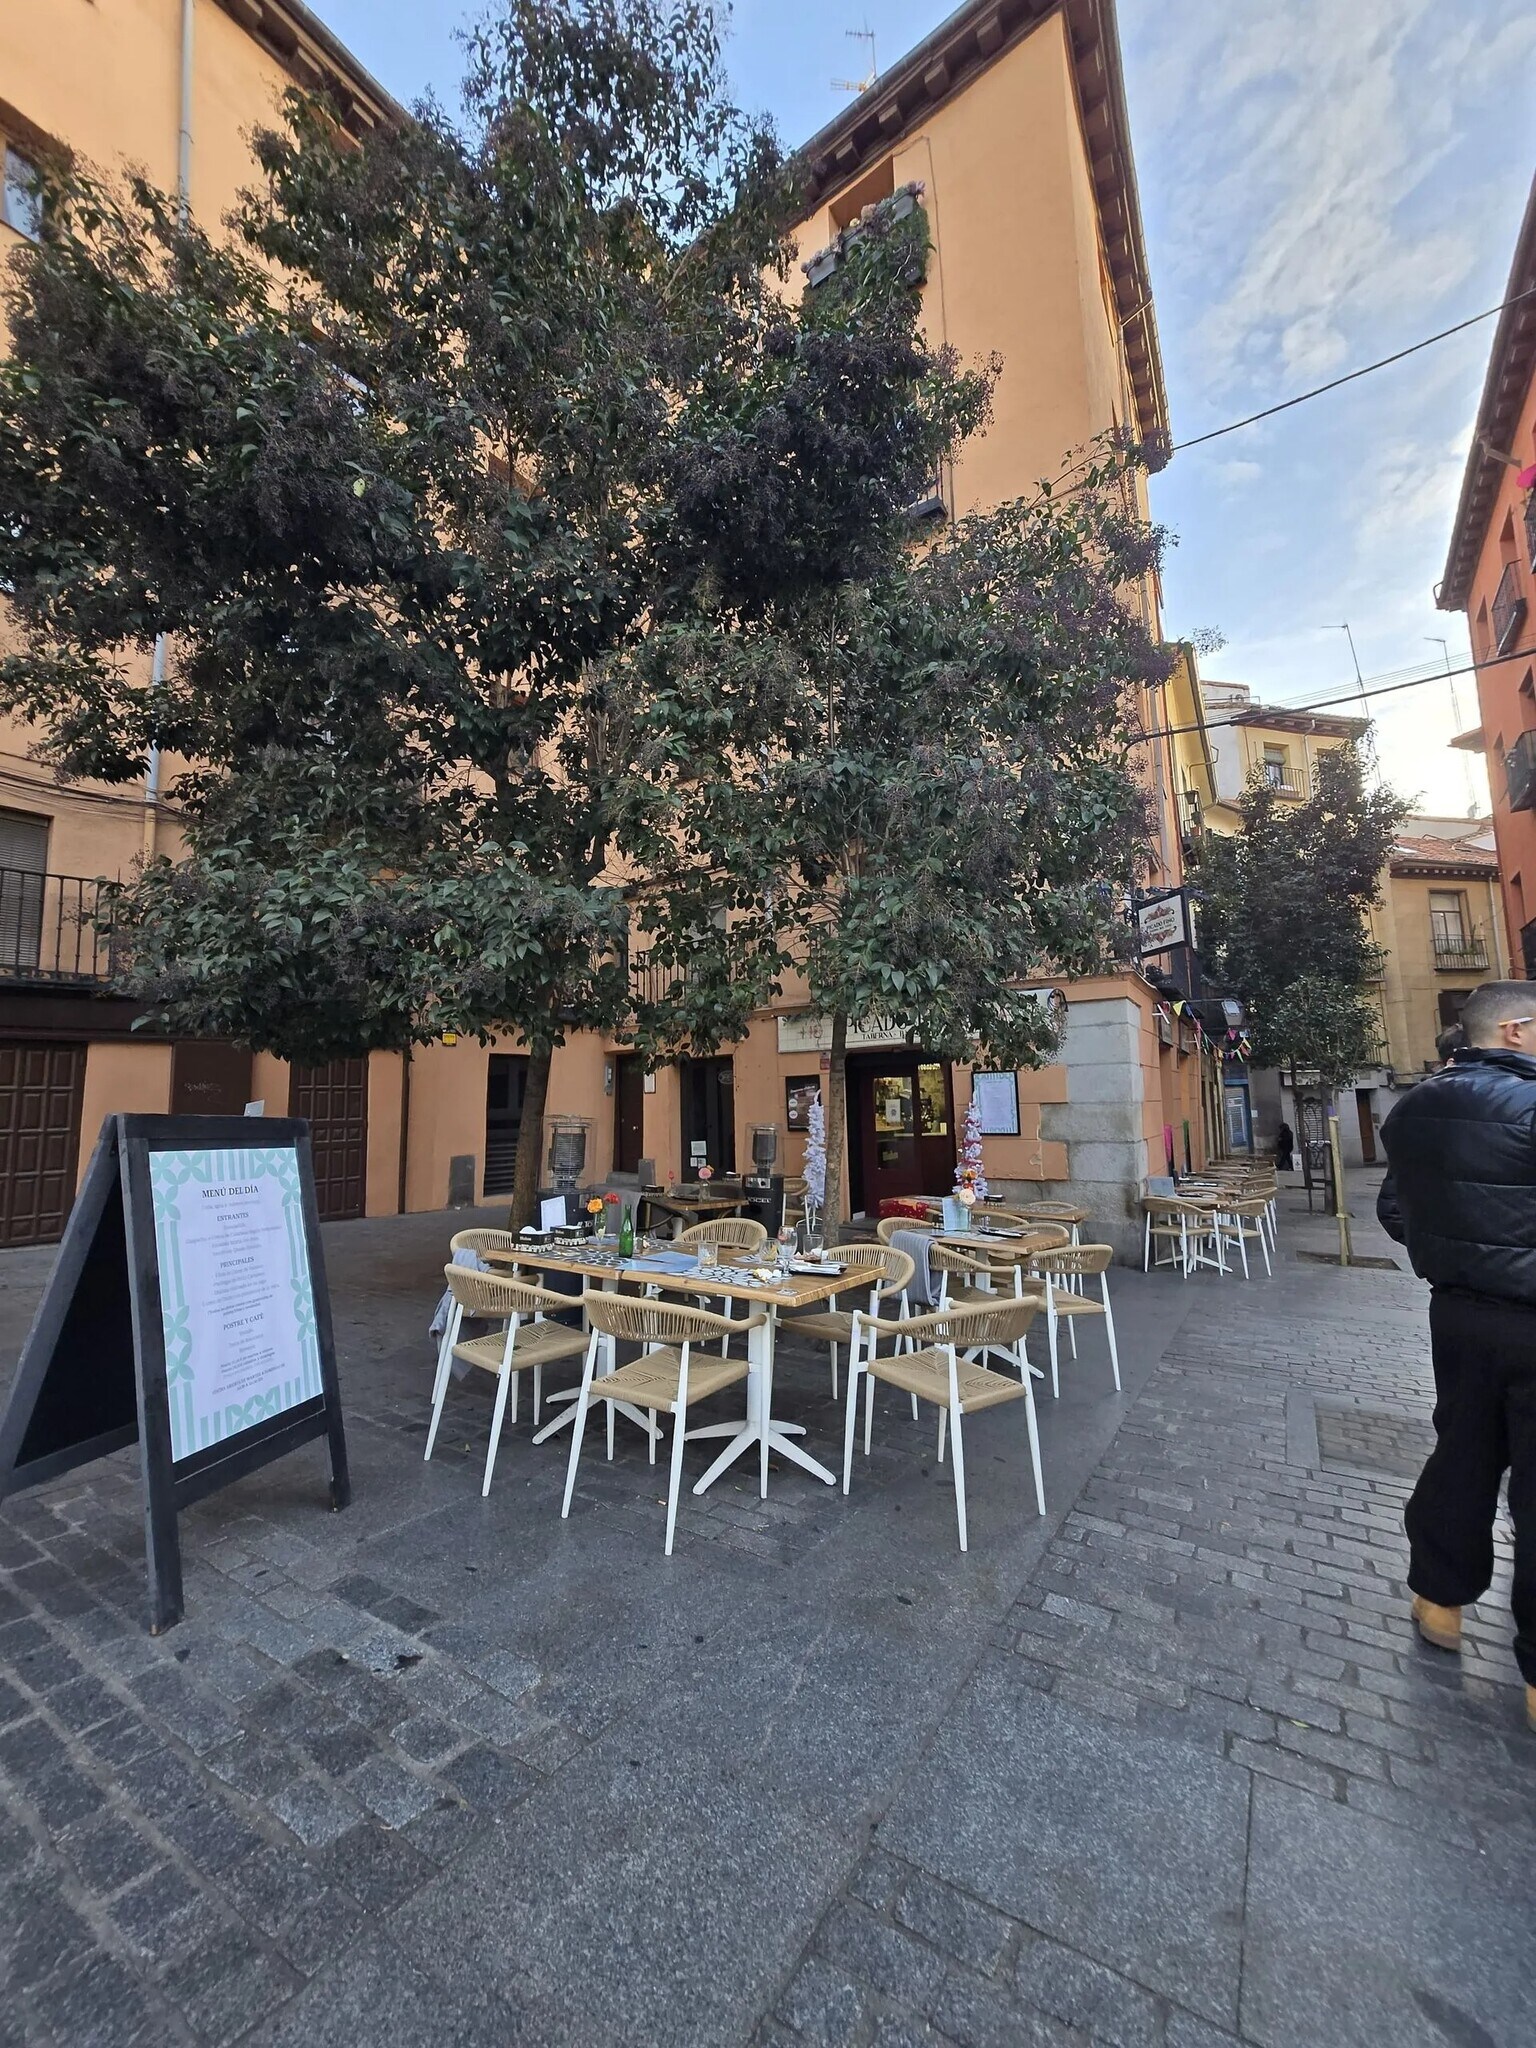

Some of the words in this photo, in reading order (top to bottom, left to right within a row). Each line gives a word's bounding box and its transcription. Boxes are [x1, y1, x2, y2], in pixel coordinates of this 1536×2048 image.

[862, 1031, 893, 1040] TABERNA
[202, 1187, 227, 1198] MENÚ
[229, 1186, 244, 1196] DEL
[245, 1184, 259, 1194] DÍA
[216, 1211, 249, 1222] ENTRANTES
[220, 1256, 255, 1269] PRINCIPALES
[223, 1320, 244, 1331] POSTRE
[249, 1312, 264, 1323] CAFÉ
